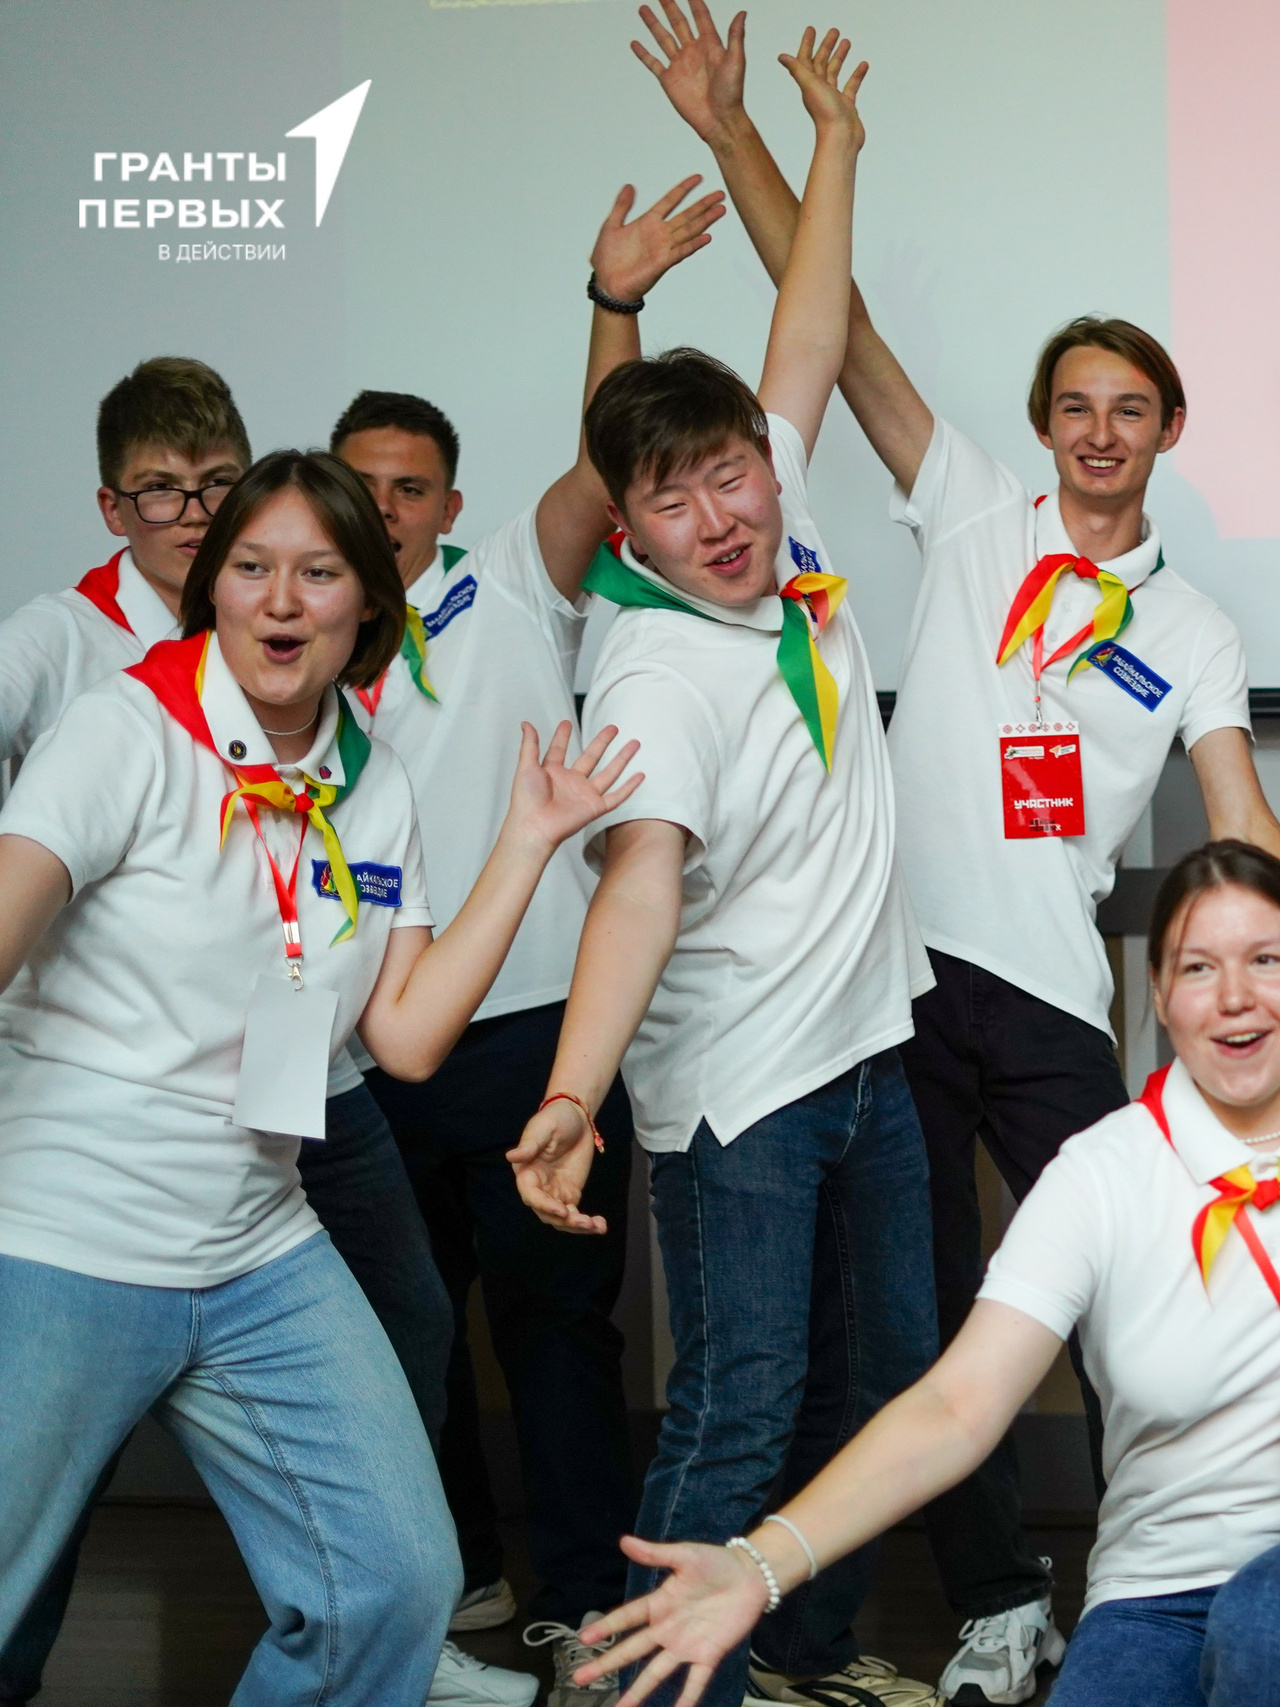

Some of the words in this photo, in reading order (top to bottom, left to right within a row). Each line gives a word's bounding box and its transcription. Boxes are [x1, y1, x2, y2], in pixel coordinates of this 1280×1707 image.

[1112, 654, 1164, 699] ЗАБАЙКАЛЬСКОЕ
[1113, 666, 1150, 698] СОЗВЕЗДИЕ
[1014, 797, 1074, 809] УЧАСТНИК
[356, 871, 399, 888] АЙКАЛЬСКОЕ
